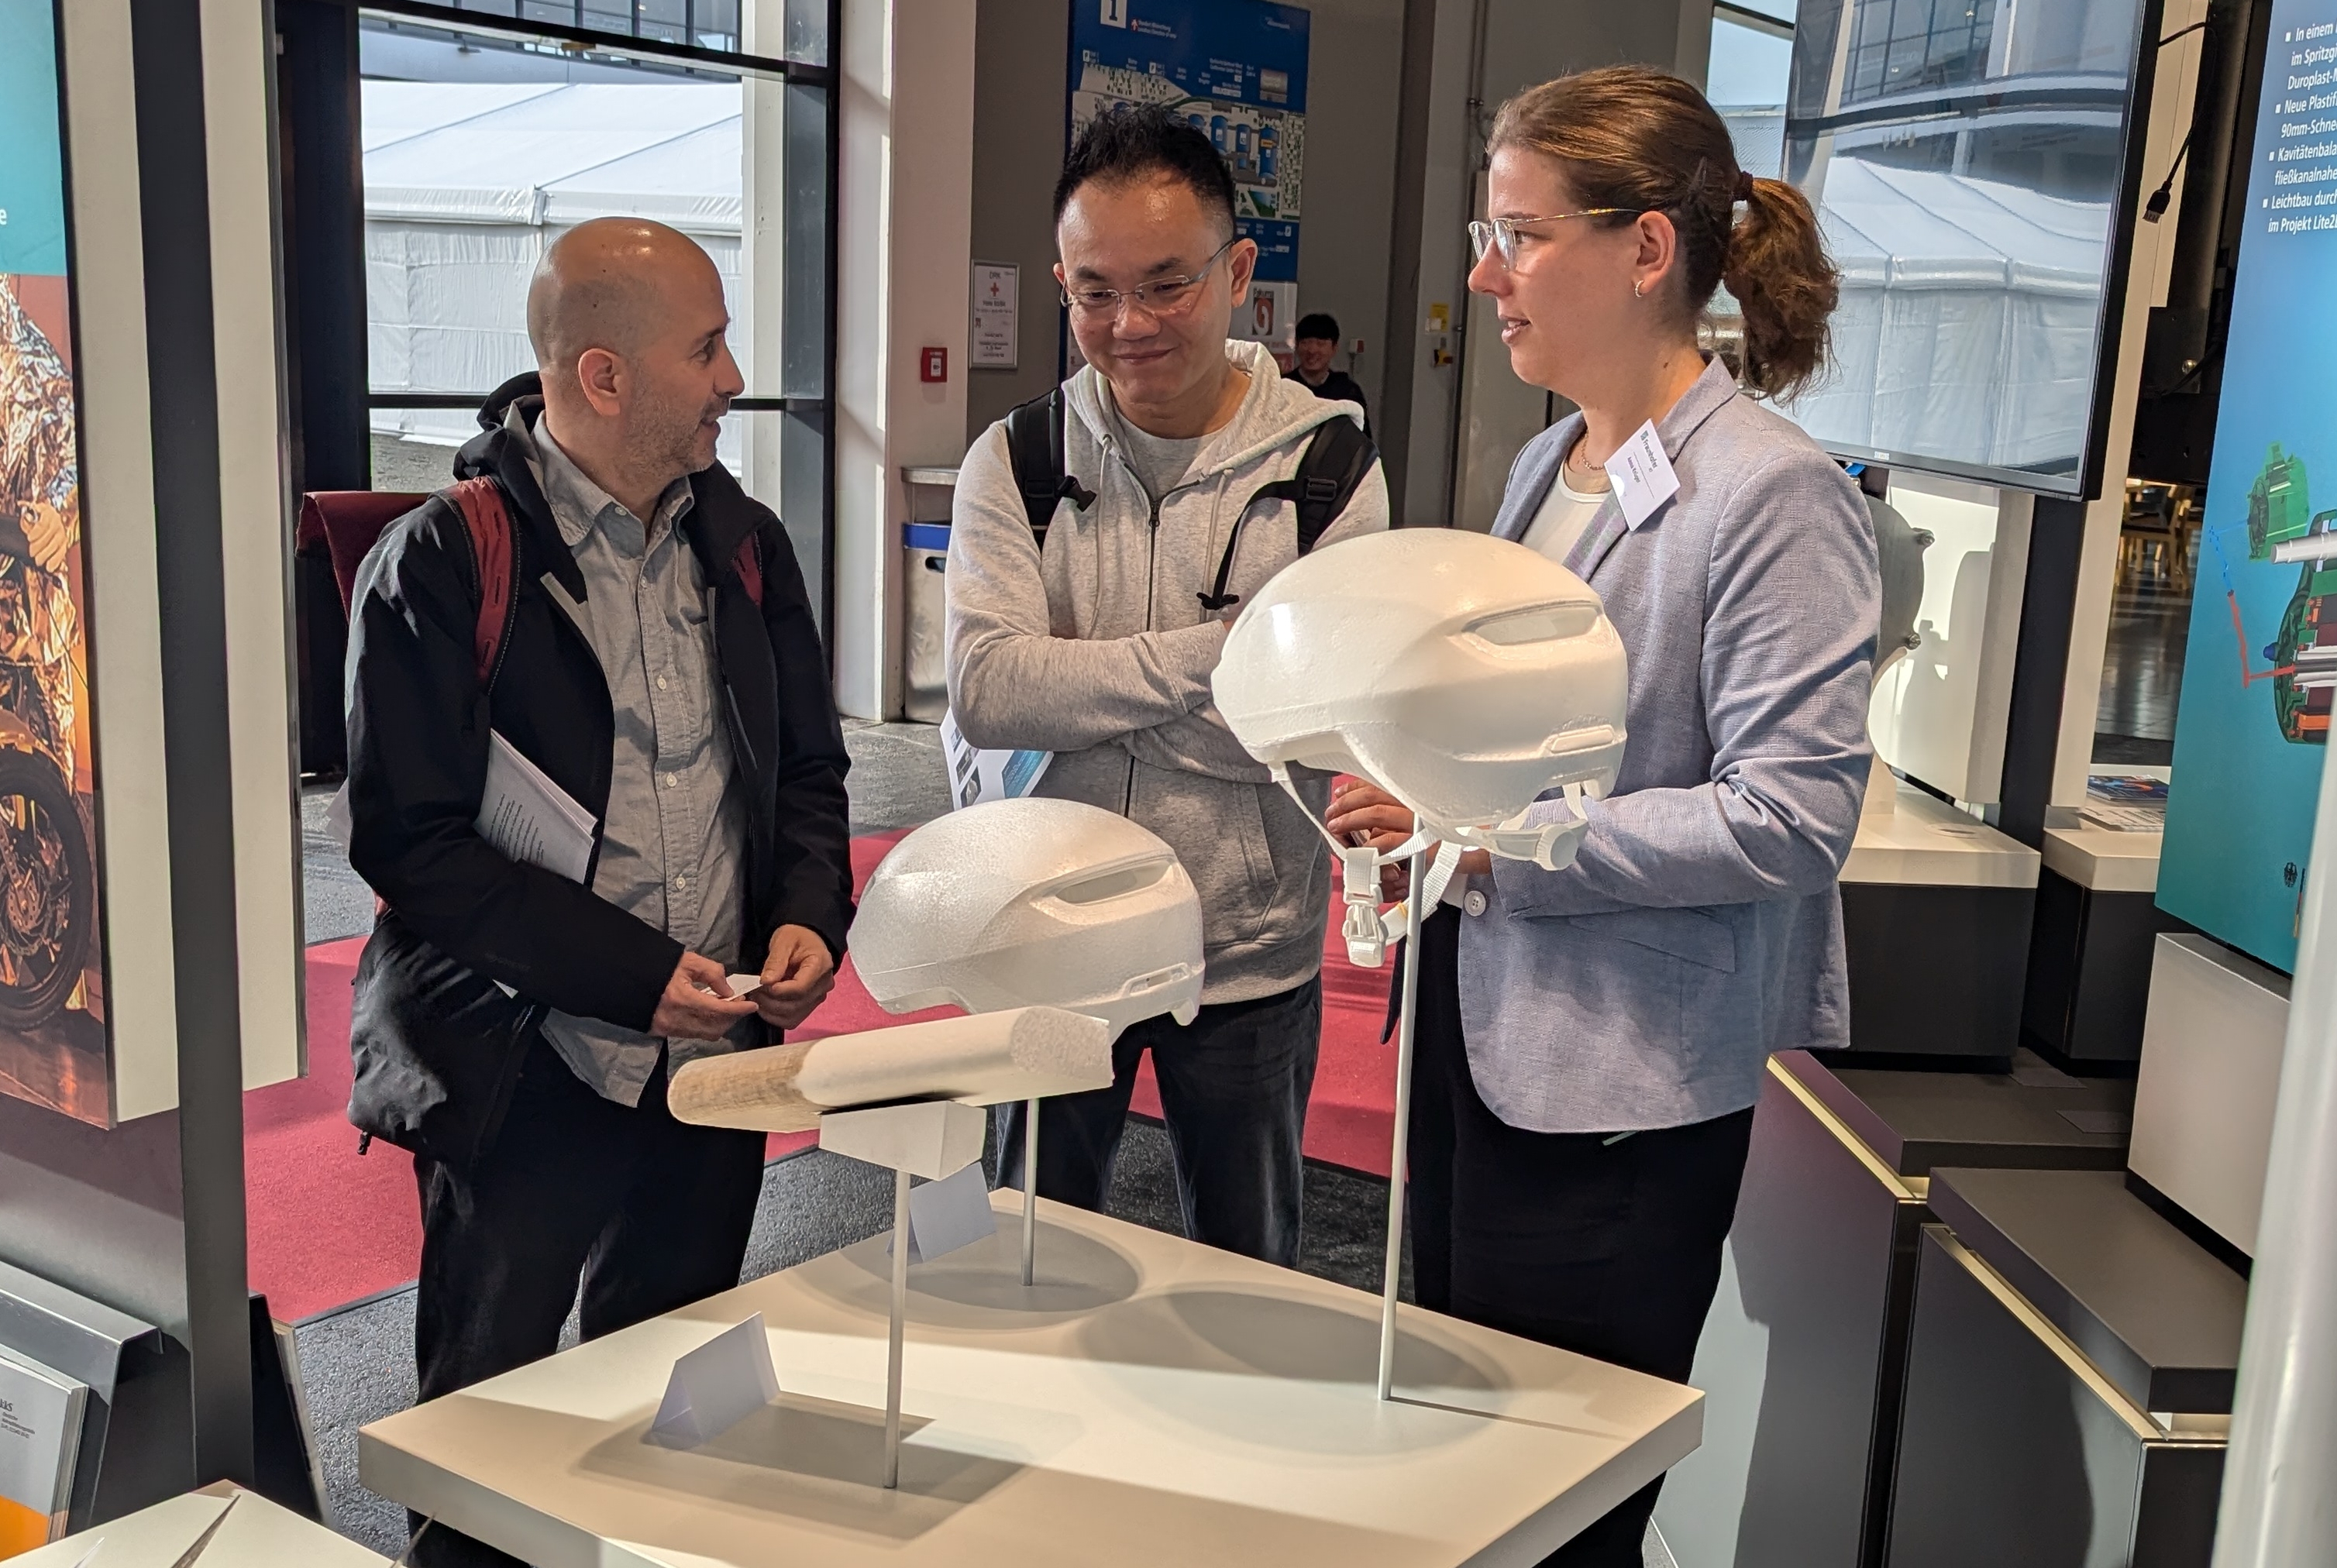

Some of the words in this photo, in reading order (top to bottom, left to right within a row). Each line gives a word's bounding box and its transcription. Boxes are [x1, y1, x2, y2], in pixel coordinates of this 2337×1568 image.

[2295, 27, 2304, 42] In
[2306, 23, 2334, 40] einem
[2291, 50, 2303, 67] im
[2284, 99, 2308, 115] Neue
[2280, 117, 2337, 139] 90mm-Schne
[2277, 140, 2337, 162] Kavitätenbala
[2274, 164, 2337, 186] fließkanalnahe
[2271, 191, 2313, 210] Leichtbau
[2268, 217, 2279, 233] im
[2280, 215, 2312, 236] Projekt
[1643, 439, 1657, 468] Fraunhofer
